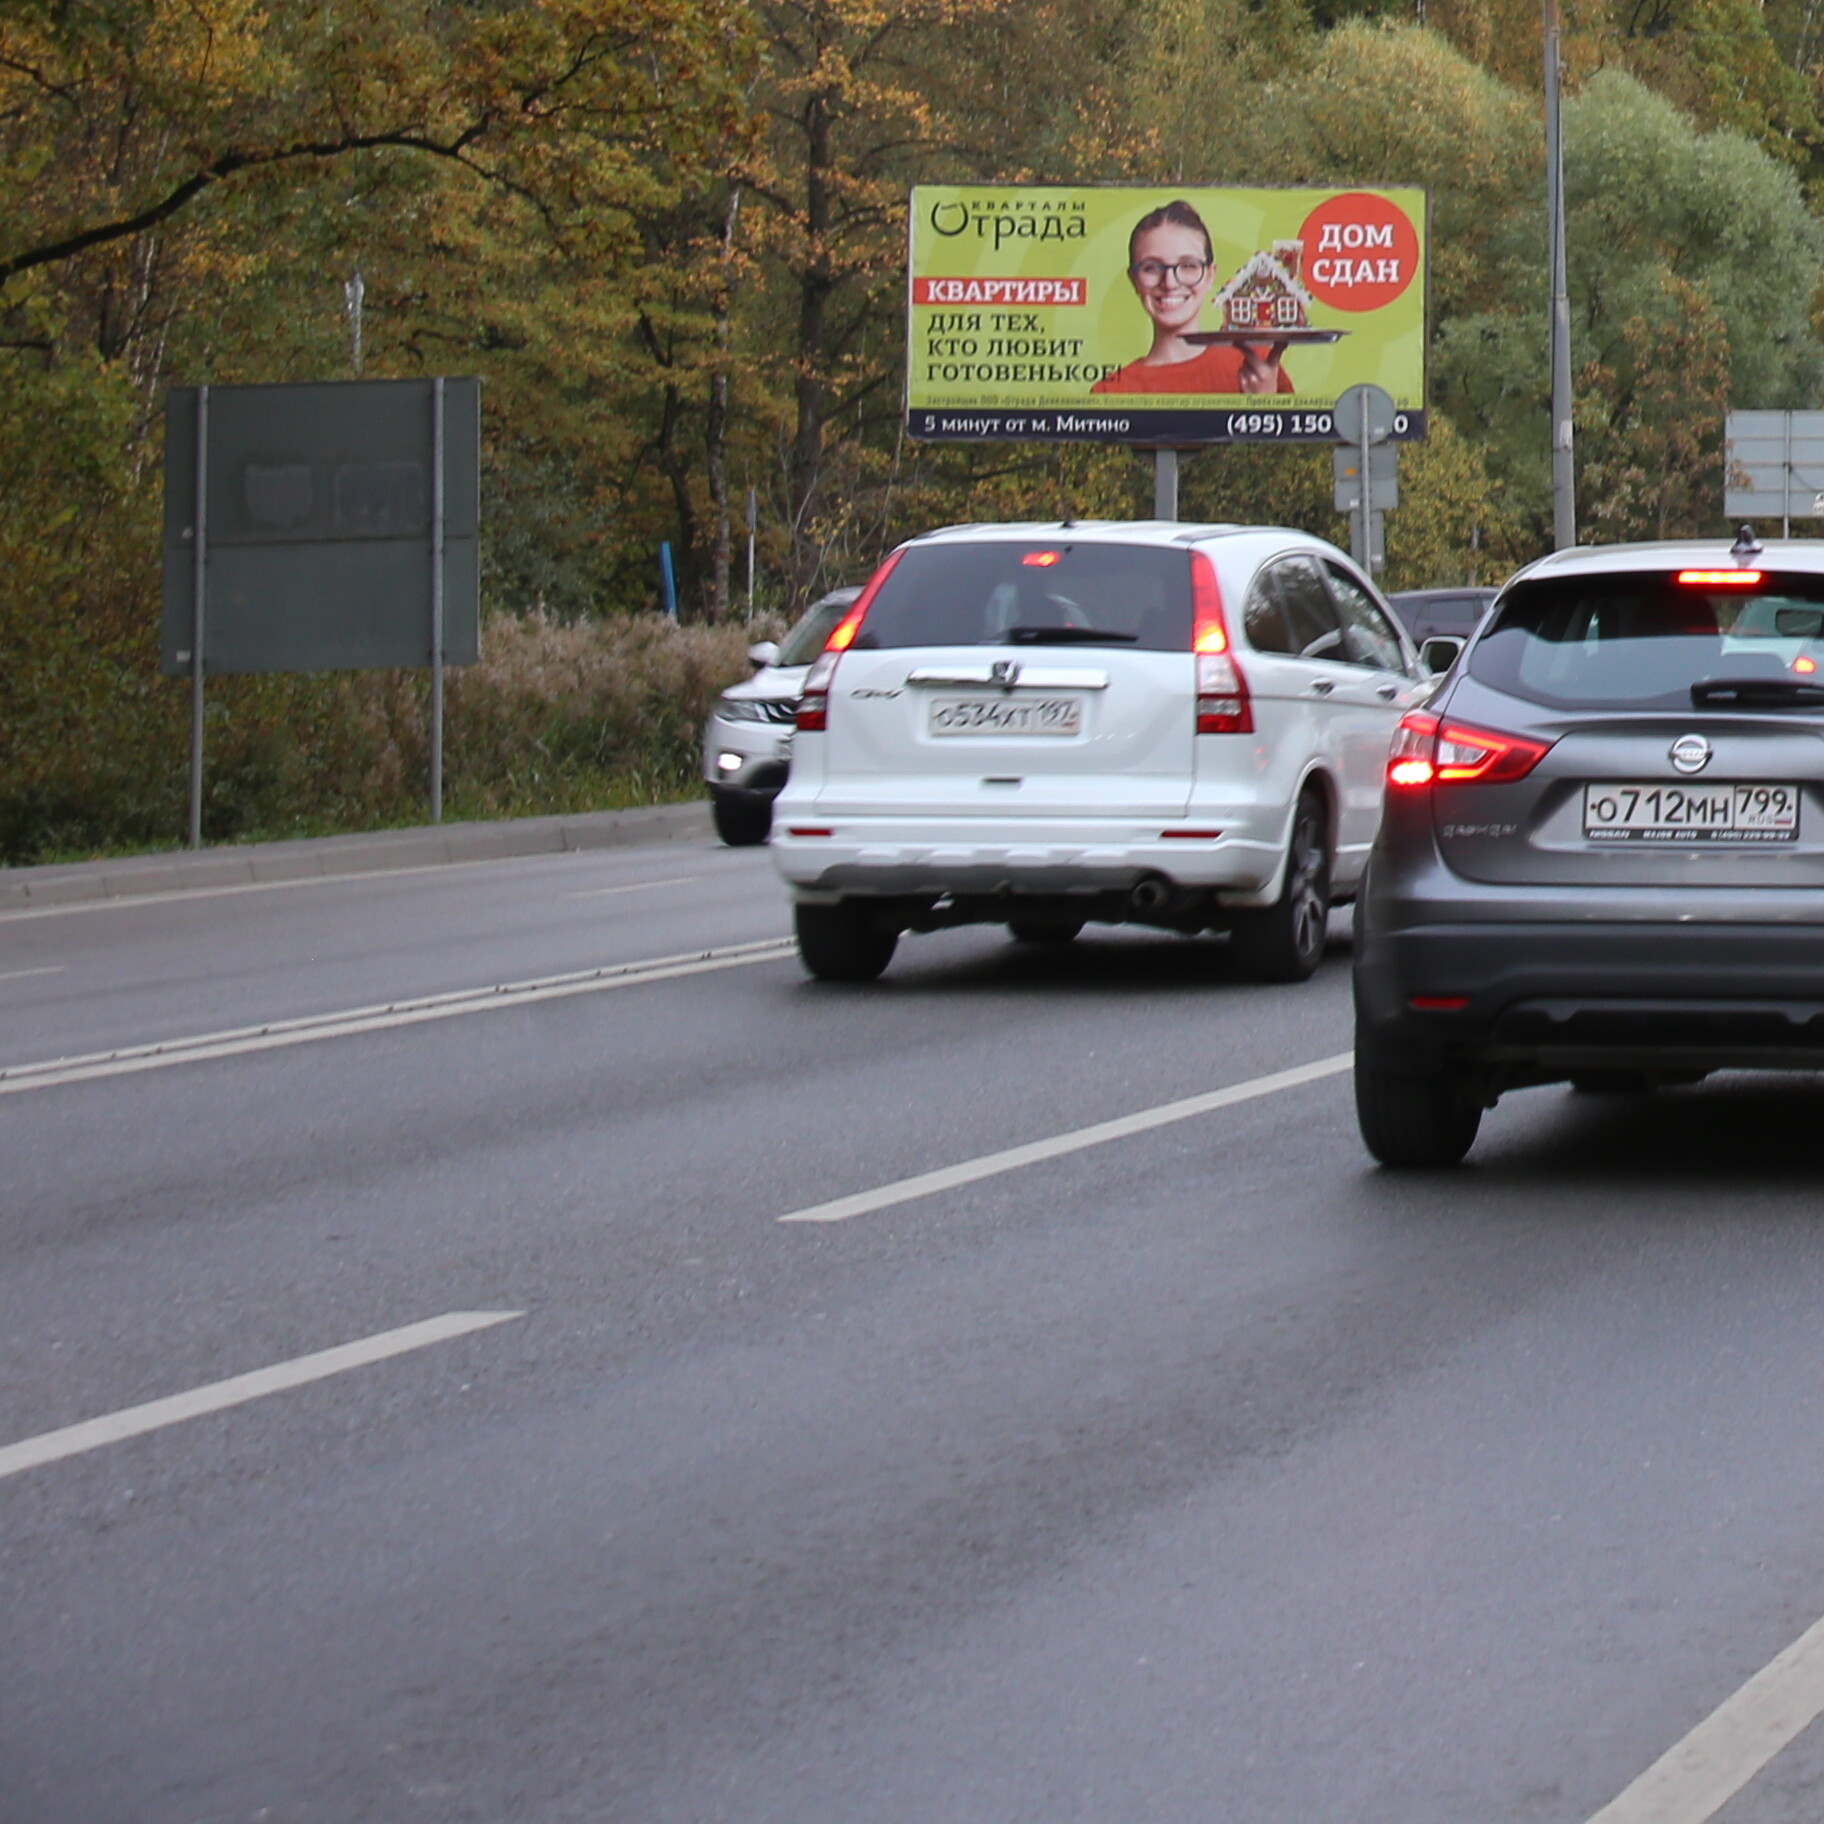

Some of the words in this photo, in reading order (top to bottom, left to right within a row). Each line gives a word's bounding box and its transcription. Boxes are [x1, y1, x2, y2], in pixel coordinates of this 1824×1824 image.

[971, 201, 1086, 211] КВАРТАЛЫ
[931, 201, 1087, 251] Отрада
[1318, 223, 1394, 253] ДОМ
[1312, 258, 1400, 288] СДАН
[927, 279, 1081, 302] КВАРТИРЫ
[927, 313, 981, 335] ДЛЯ
[990, 313, 1046, 334] ТЕХ,
[927, 339, 978, 357] КТО
[986, 339, 1084, 357] ЛЮБИТ
[927, 364, 1122, 382] ГОТОВЕНЬКОЕ!
[924, 416, 935, 433] 5
[942, 419, 1001, 436] минут
[1005, 419, 1027, 433] от
[1032, 419, 1050, 433] м.
[1056, 416, 1130, 433] Митино
[1227, 414, 1282, 436] (495)
[1291, 415, 1332, 434] 150
[1597, 789, 1729, 824] О712МН
[1737, 788, 1788, 815] 799
